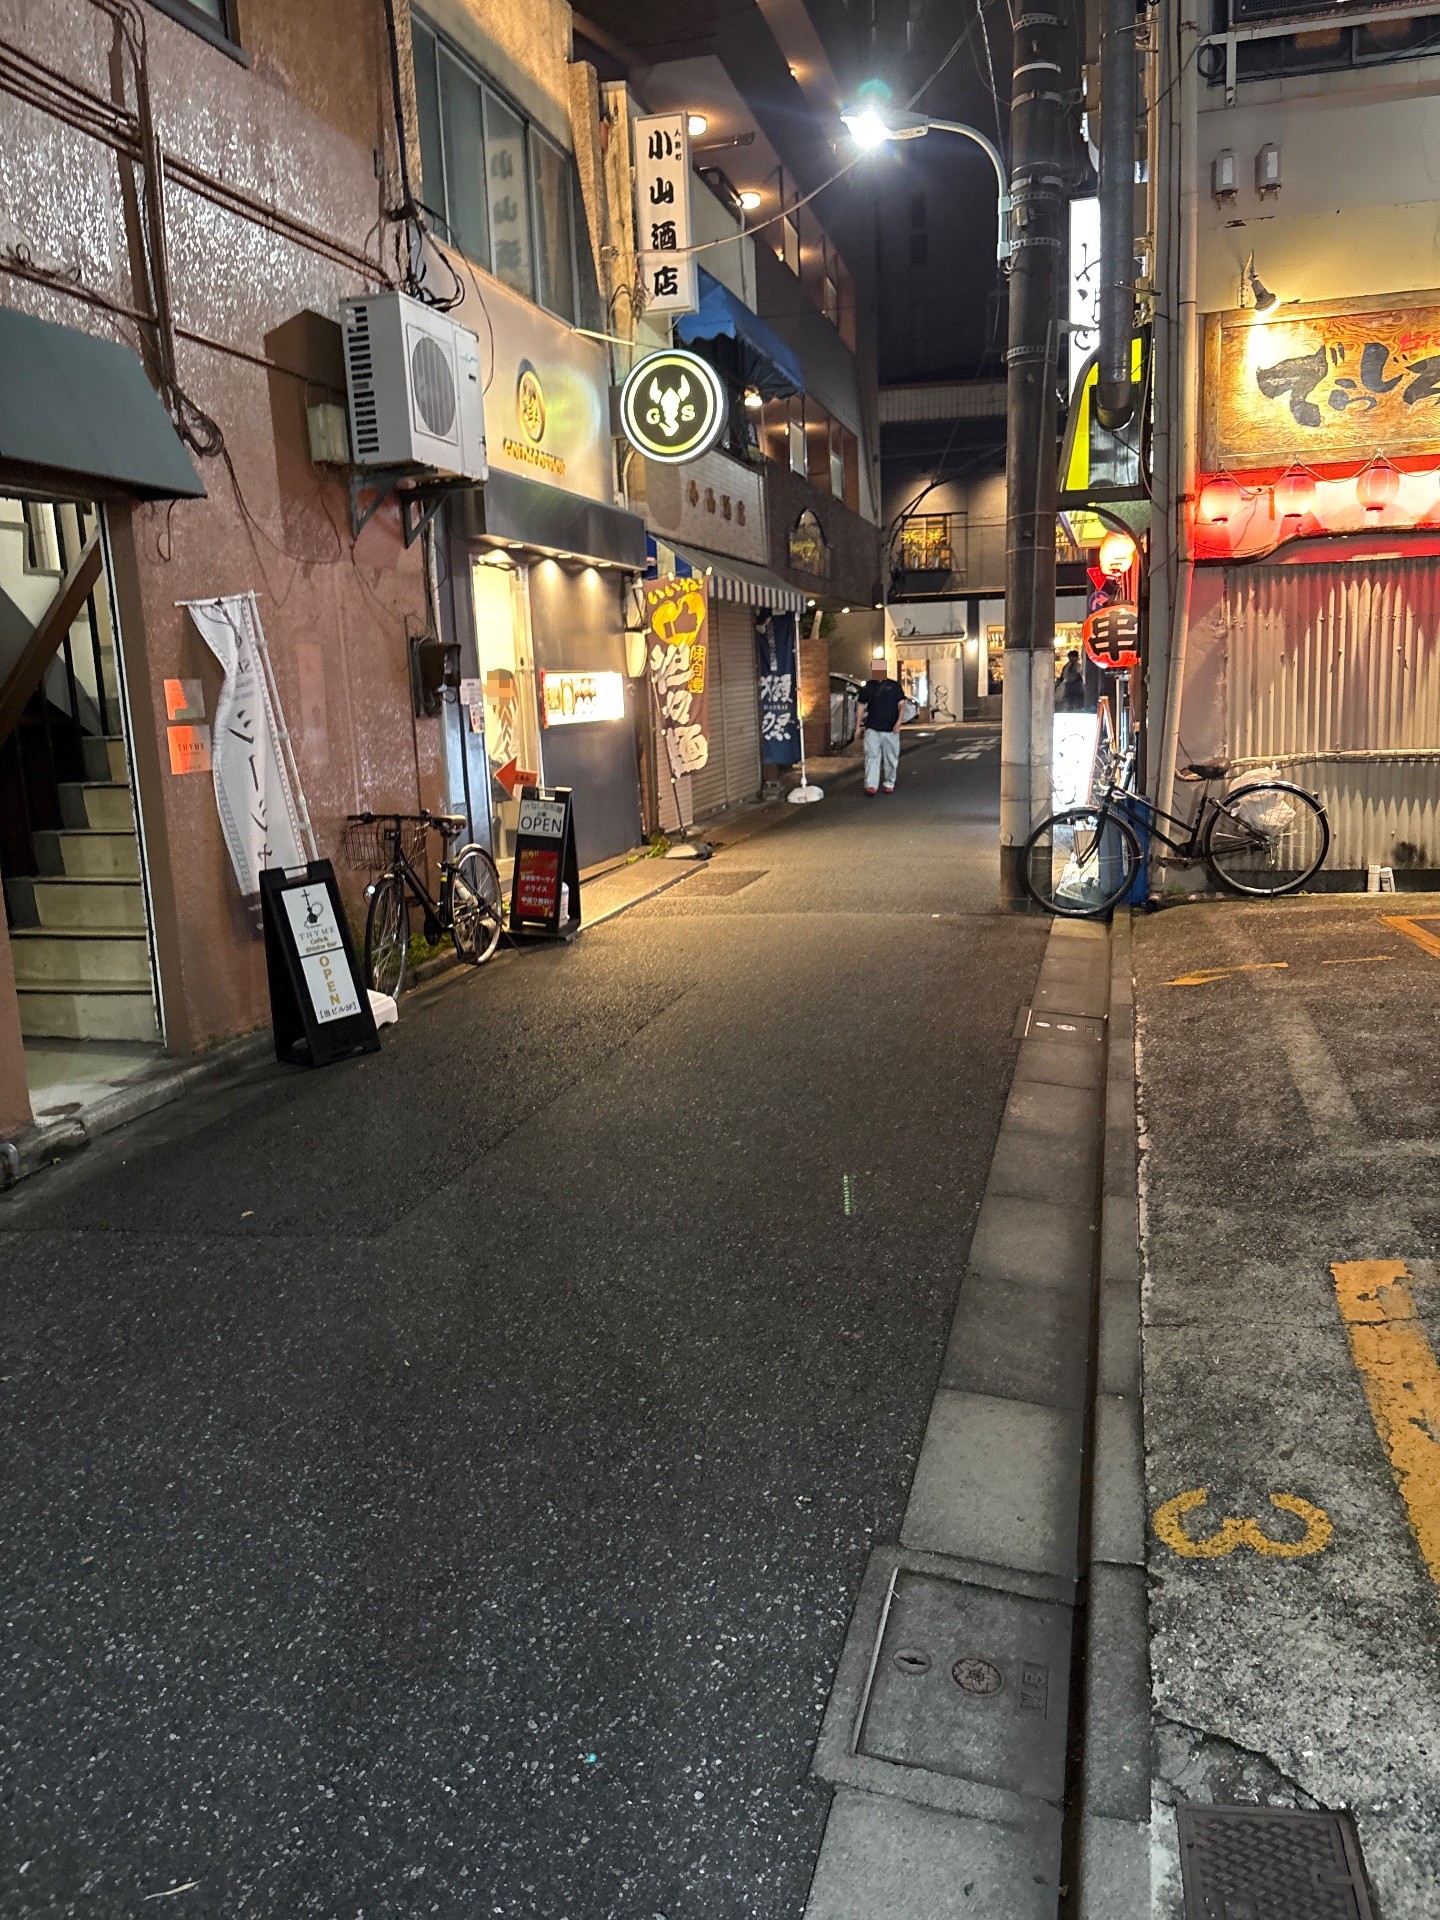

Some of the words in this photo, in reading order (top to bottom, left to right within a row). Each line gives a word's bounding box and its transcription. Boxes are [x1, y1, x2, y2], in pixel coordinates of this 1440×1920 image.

[648, 130, 679, 296] 小山酒店
[681, 404, 696, 422] S
[1089, 611, 1138, 662] 串
[521, 815, 562, 833] OPEN
[299, 926, 335, 941] THYME
[319, 955, 341, 1006] OPEN
